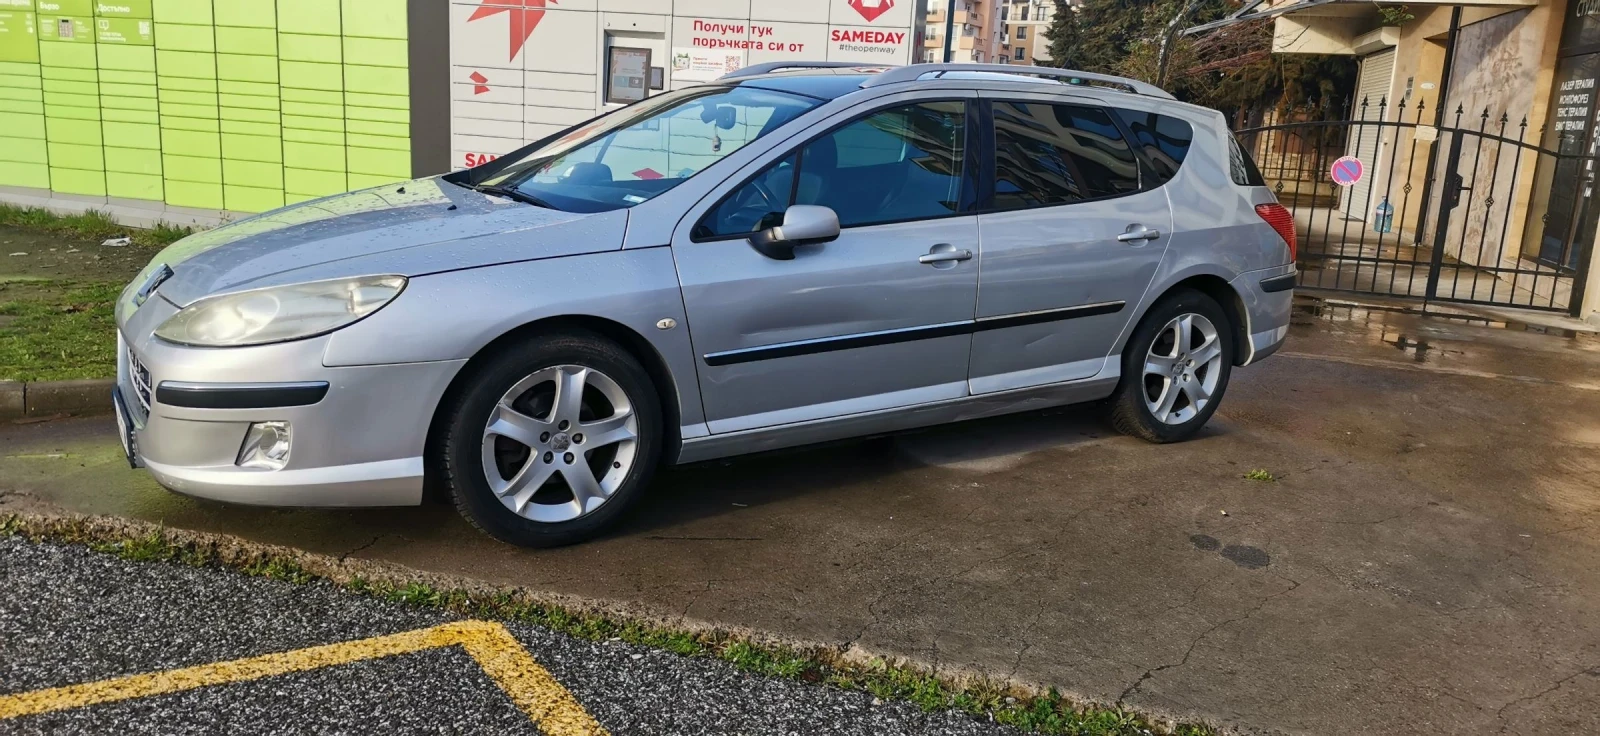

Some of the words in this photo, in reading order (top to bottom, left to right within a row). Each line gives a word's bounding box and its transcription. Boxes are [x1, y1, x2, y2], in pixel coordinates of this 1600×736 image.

[693, 20, 744, 35] Получи
[751, 25, 773, 37] тук
[831, 29, 905, 44] SAMEDAY
[693, 37, 763, 50] поръчката
[768, 42, 784, 51] си
[789, 43, 804, 52] от
[839, 44, 896, 54] #theopenway
